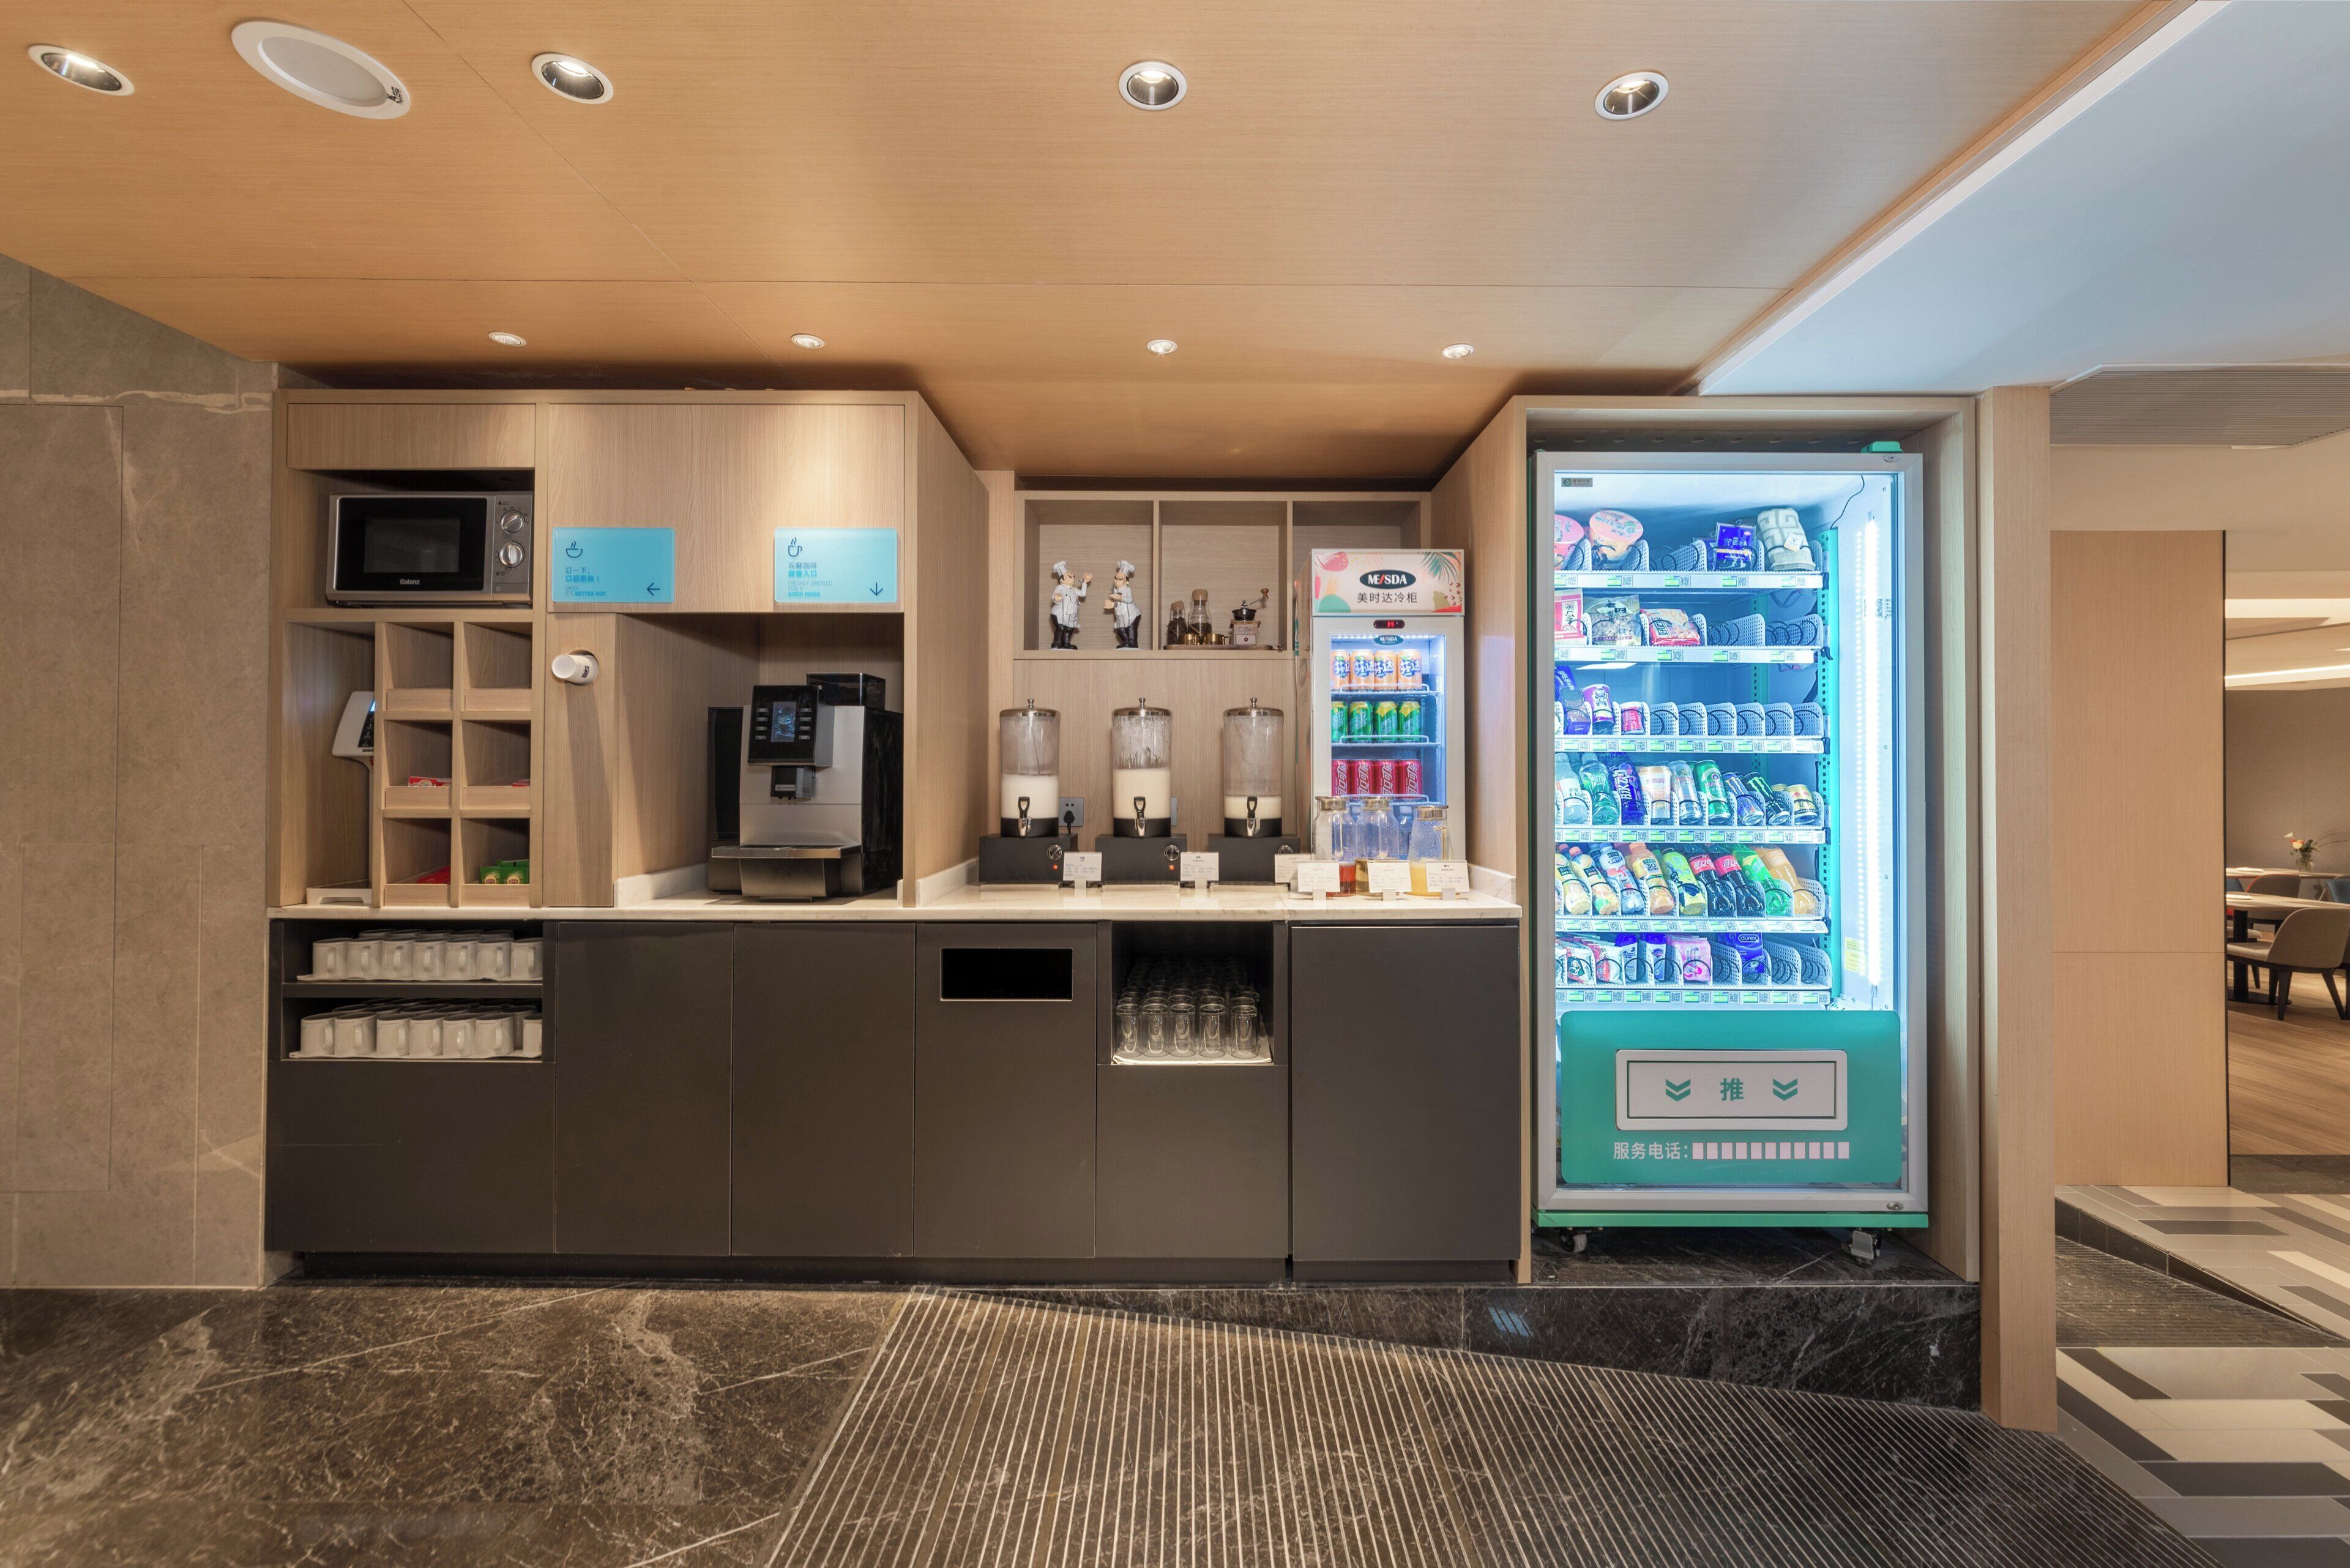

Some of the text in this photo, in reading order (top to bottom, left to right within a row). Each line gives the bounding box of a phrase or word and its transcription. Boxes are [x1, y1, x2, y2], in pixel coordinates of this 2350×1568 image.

[1357, 592, 1417, 603] 美时达冷柜
[1720, 1077, 1744, 1102] 推
